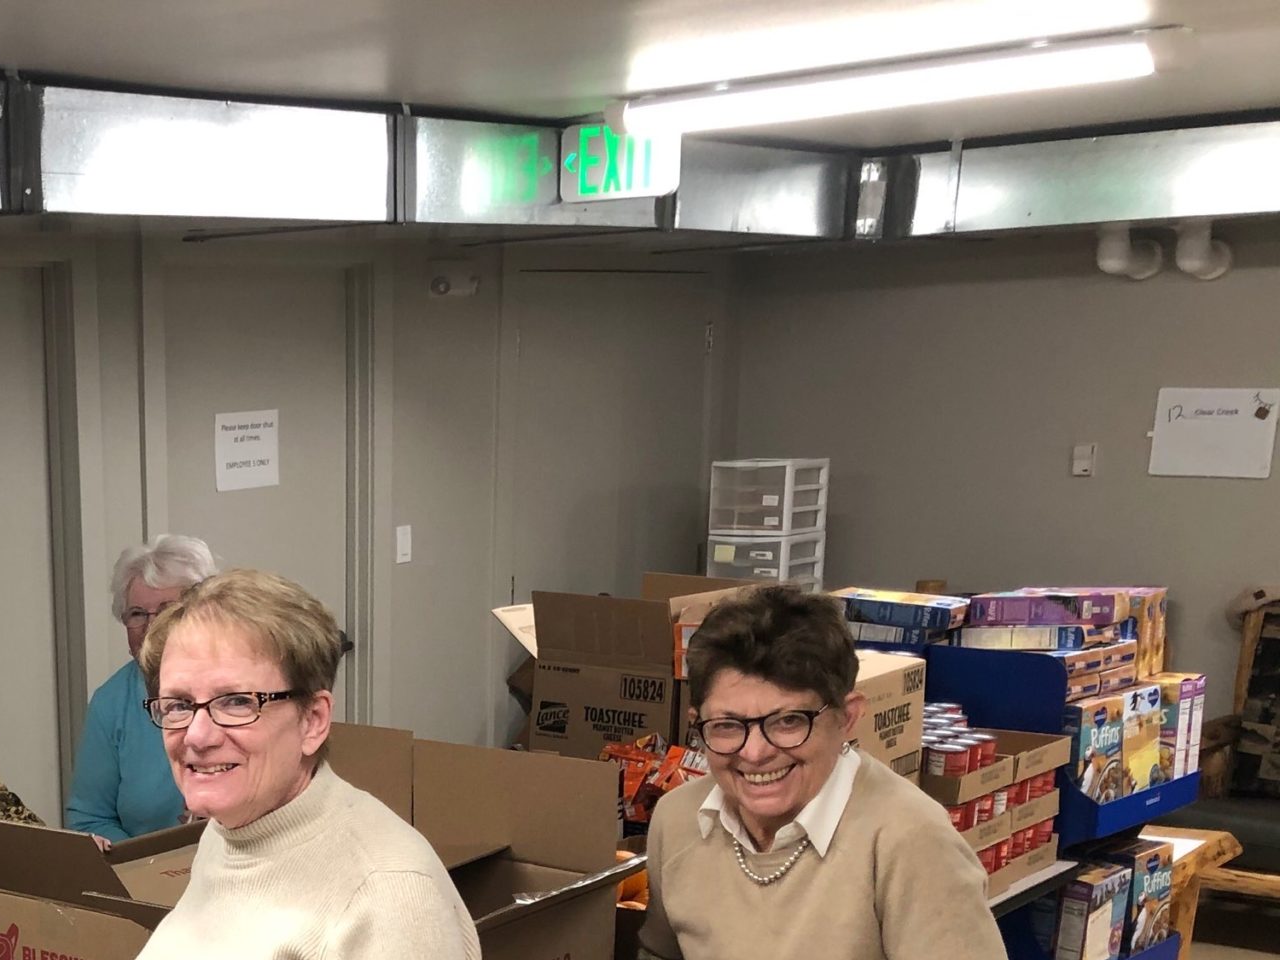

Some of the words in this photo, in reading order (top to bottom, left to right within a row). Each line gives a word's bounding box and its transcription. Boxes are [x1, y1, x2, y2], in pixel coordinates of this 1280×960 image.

[1168, 404, 1185, 423] 12
[622, 677, 664, 702] 105824
[536, 709, 569, 727] Lance
[584, 705, 648, 729] TOASTCHEE
[873, 702, 912, 733] TOASTCHEE
[1091, 726, 1120, 749] Puffins
[1144, 870, 1172, 893] Puffins
